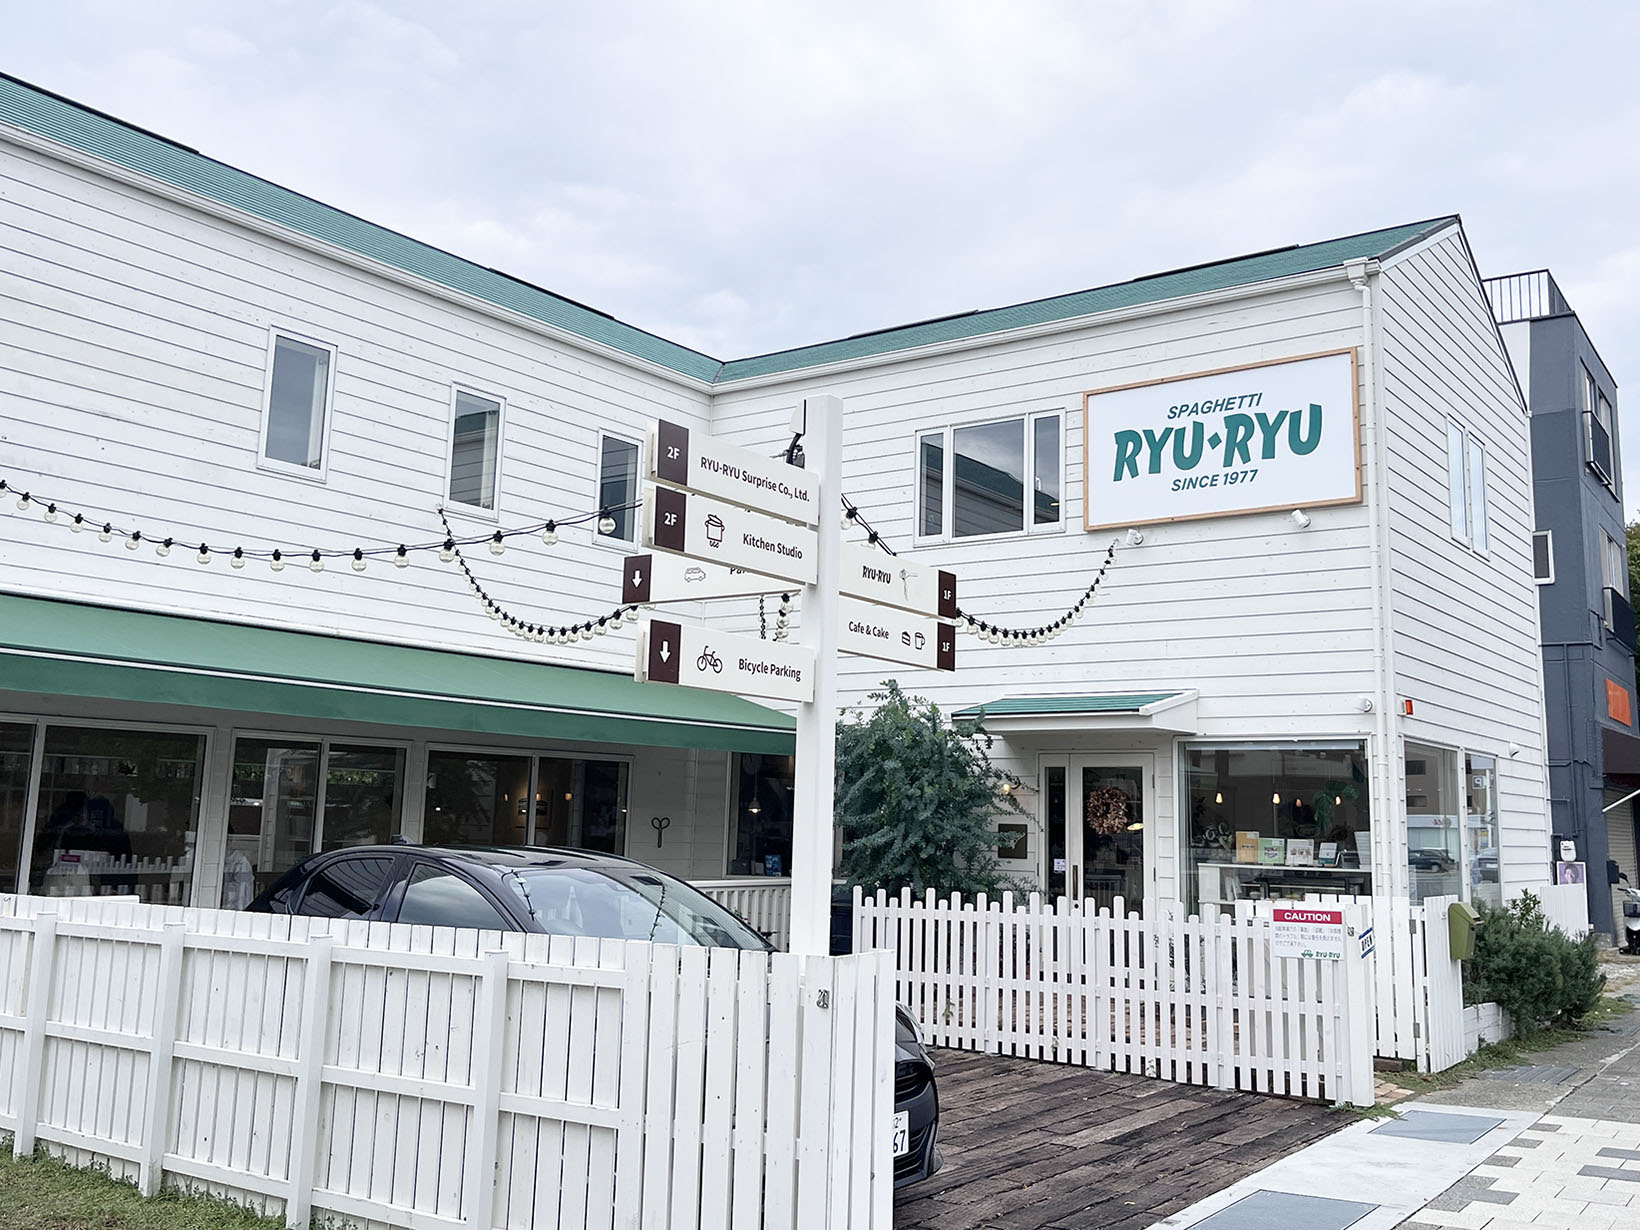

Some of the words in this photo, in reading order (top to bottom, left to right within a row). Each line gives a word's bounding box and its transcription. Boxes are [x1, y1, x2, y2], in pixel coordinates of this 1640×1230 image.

[1167, 392, 1263, 420] SPAGHETTI
[667, 446, 681, 460] 2F
[700, 456, 740, 481] RYU-RYU
[741, 470, 777, 494] Surprise
[778, 480, 793, 499] Co.,
[794, 486, 810, 502] Ltd.
[1171, 474, 1220, 492] SINCE
[1223, 469, 1259, 486] 1977
[664, 512, 678, 526] 2F
[742, 532, 775, 553] Kitchen
[776, 541, 803, 560] Studio
[943, 589, 952, 601] 1F
[848, 620, 864, 634] Cafe
[865, 625, 872, 635] &
[872, 625, 890, 640] Cake
[942, 642, 950, 653] 1F
[738, 658, 768, 675] Bicycle
[769, 663, 802, 682] Parking
[1284, 912, 1331, 922] CAUTION
